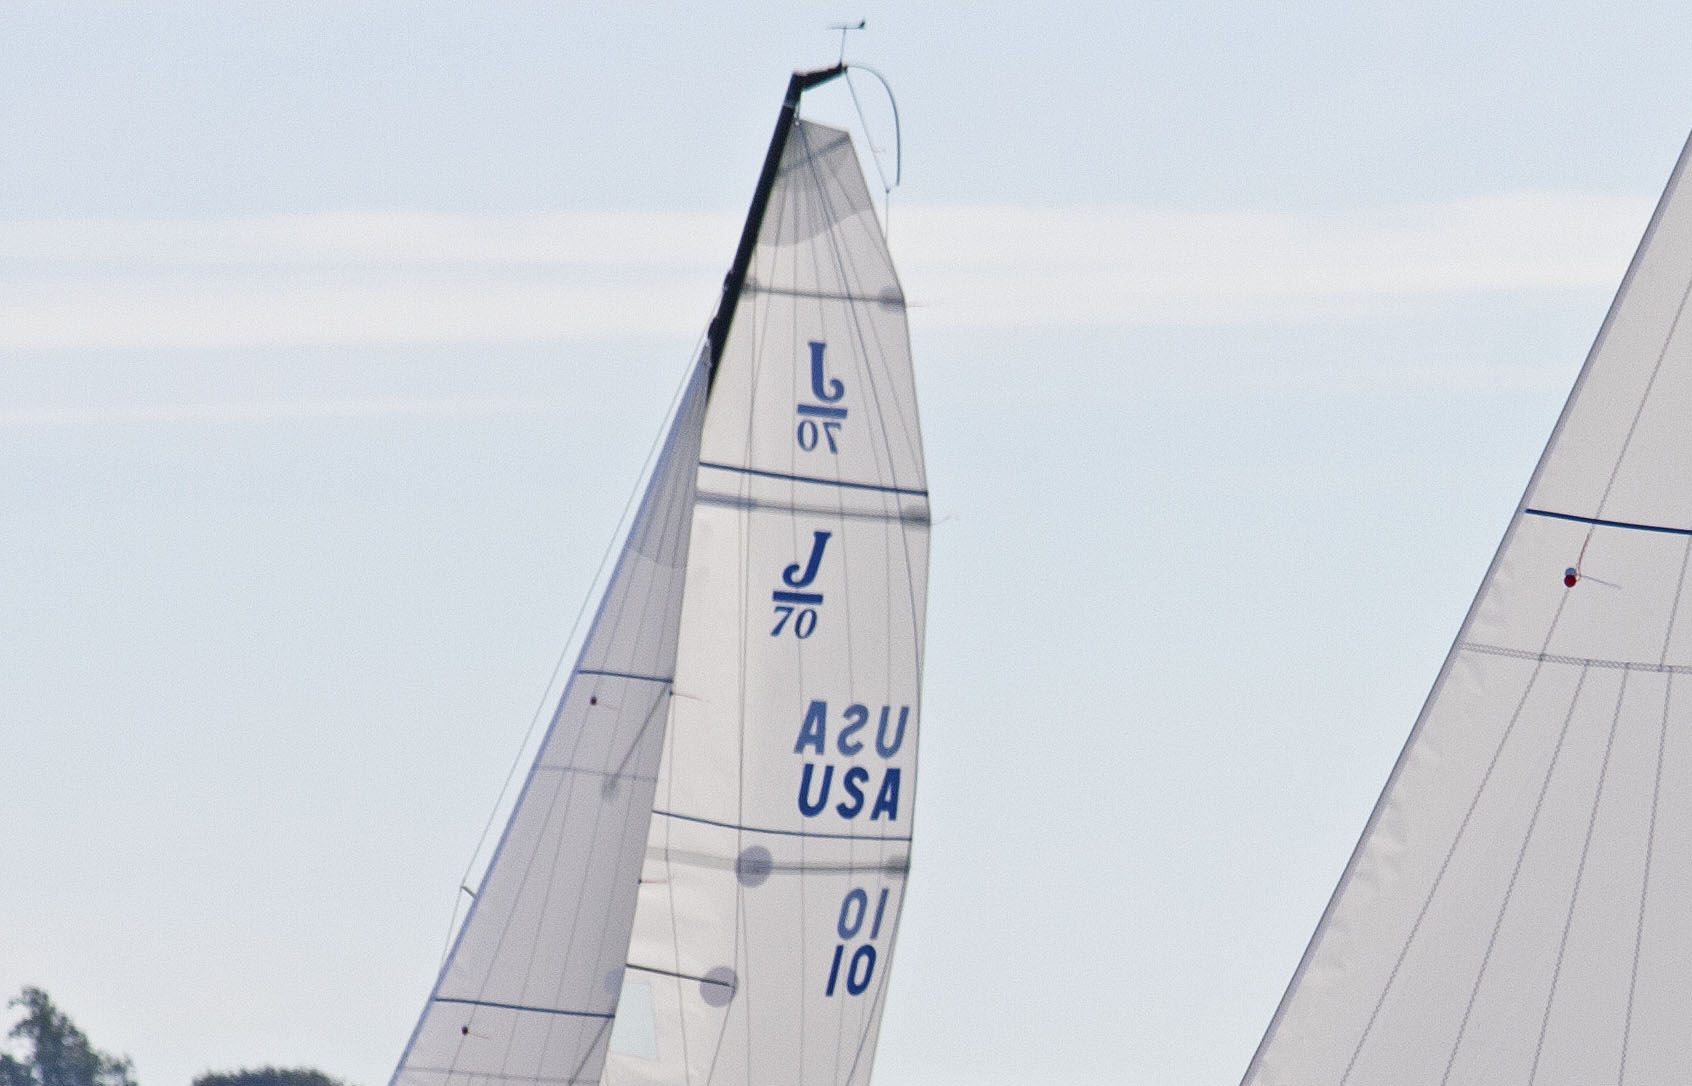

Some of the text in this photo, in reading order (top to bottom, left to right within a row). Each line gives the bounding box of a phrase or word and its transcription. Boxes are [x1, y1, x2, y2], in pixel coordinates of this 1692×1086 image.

[782, 531, 832, 588] J
[770, 606, 818, 639] 70
[798, 763, 901, 821] USA
[825, 944, 877, 997] 10
